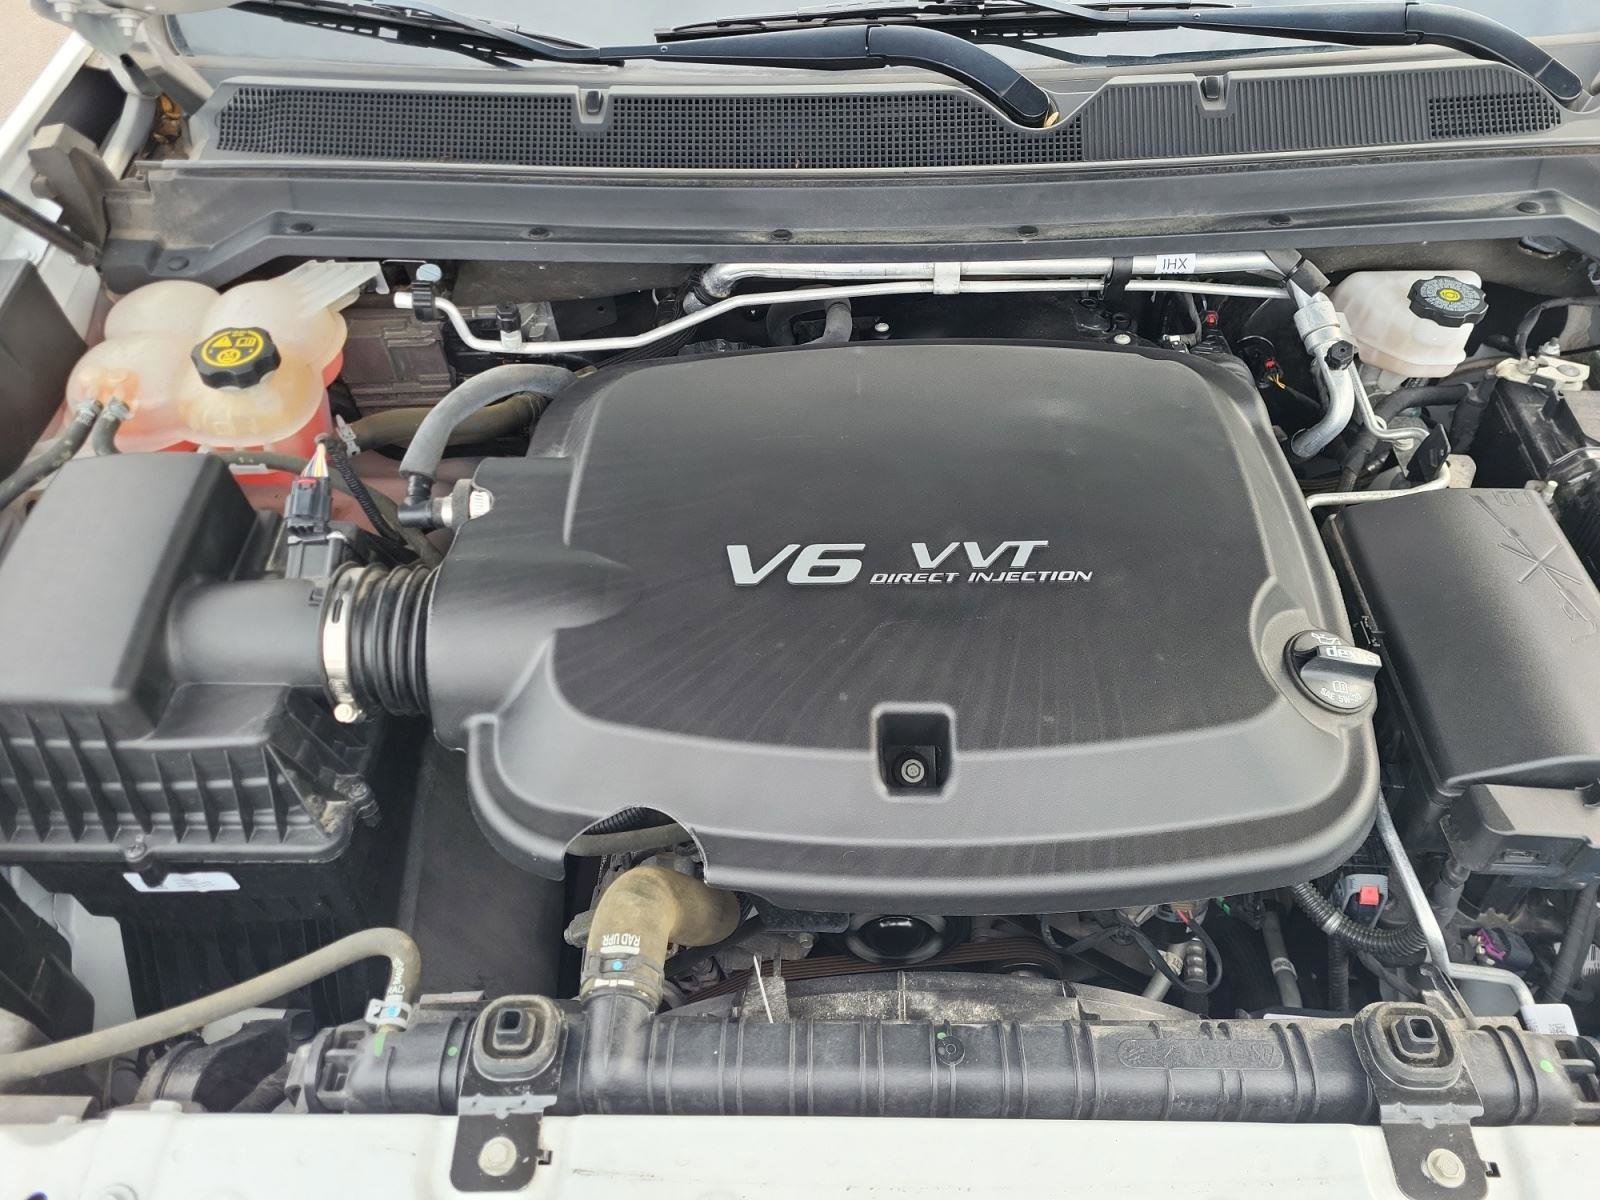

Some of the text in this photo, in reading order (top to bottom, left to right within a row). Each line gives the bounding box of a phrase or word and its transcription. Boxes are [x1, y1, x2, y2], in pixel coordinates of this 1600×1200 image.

[726, 540, 1049, 585] V6 VVT
[869, 570, 1093, 584] DIRECT INJECTION
[620, 933, 641, 947] RAD
